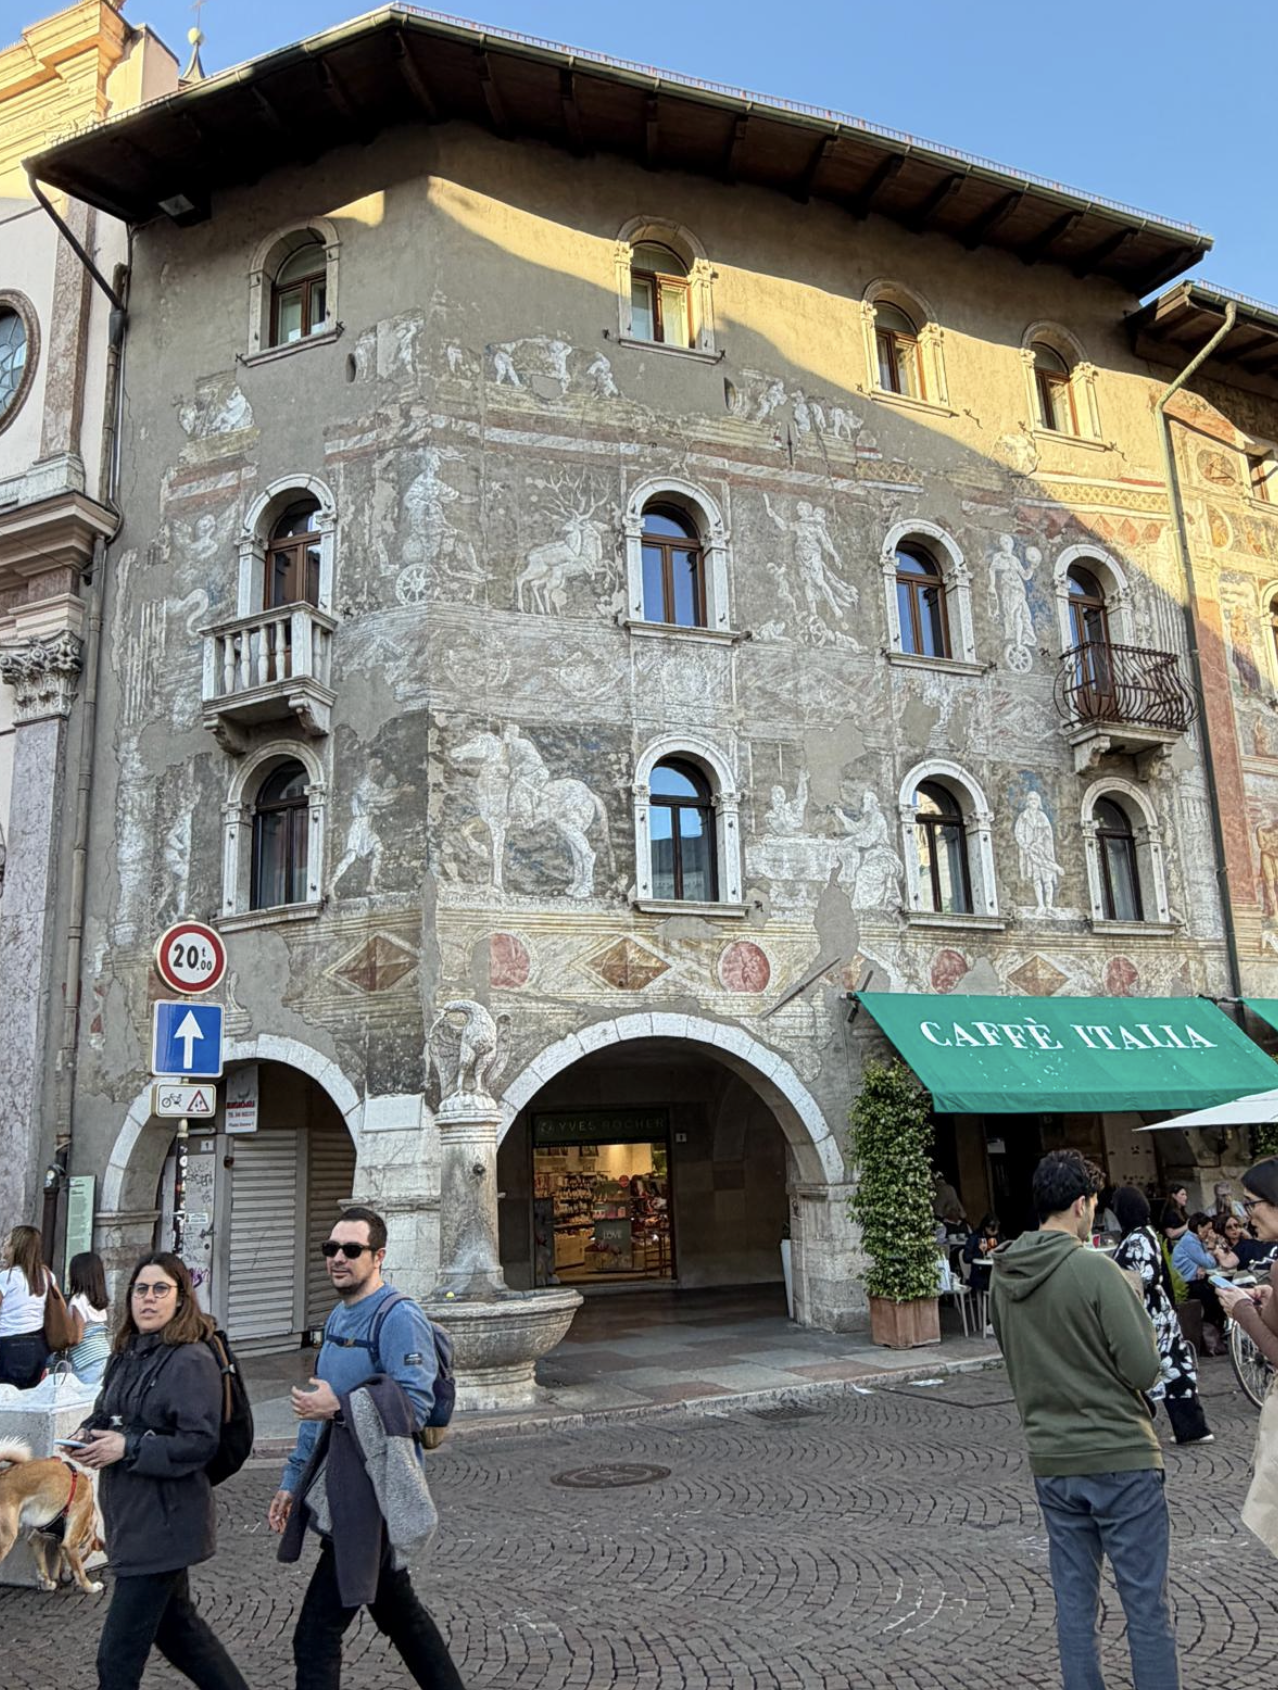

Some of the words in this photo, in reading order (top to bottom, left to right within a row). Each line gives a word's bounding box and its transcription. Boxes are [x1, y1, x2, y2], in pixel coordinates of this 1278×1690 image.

[920, 1017, 1064, 1050] CAFFÈ
[1070, 1024, 1218, 1050] ITALIA
[558, 1120, 597, 1132] YVES
[601, 1117, 665, 1131] ROCHER
